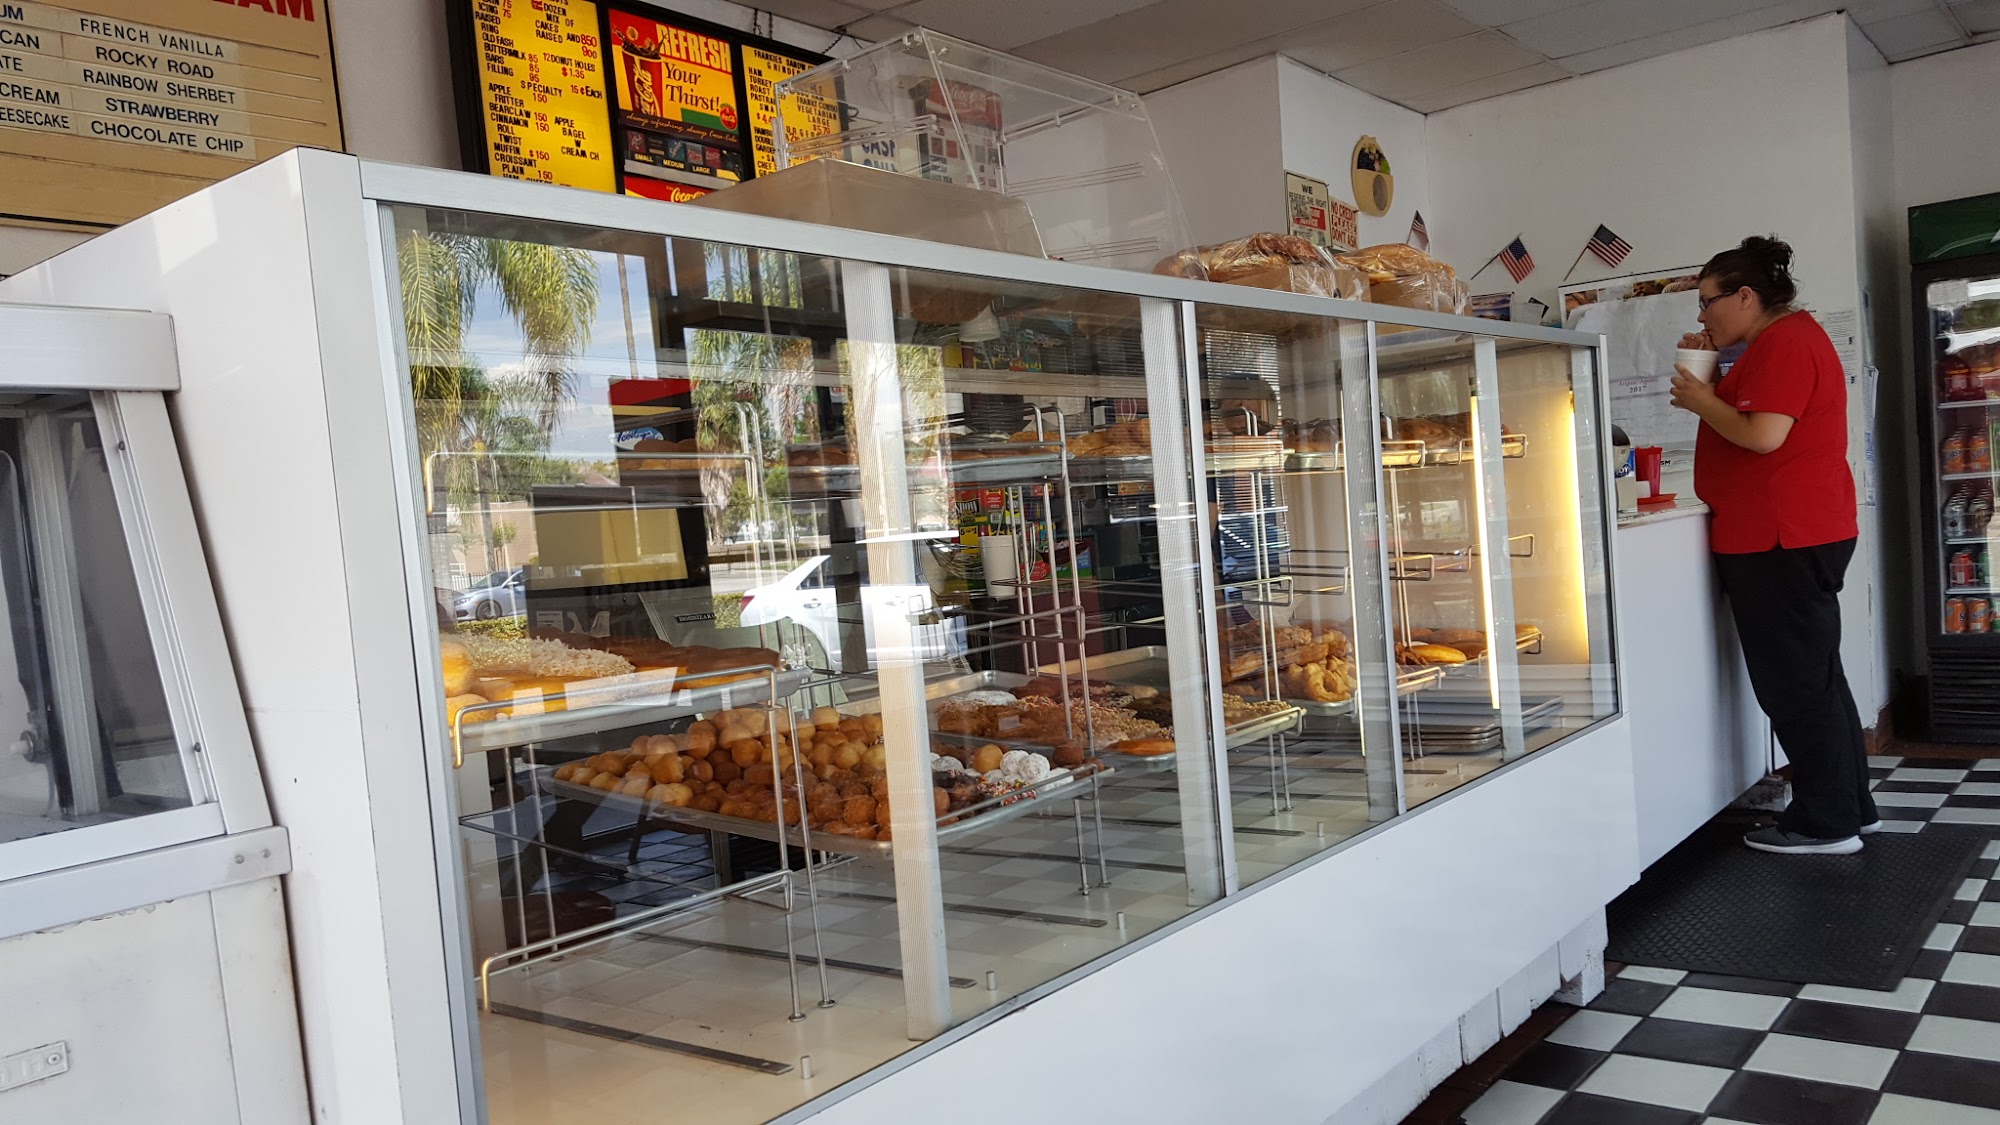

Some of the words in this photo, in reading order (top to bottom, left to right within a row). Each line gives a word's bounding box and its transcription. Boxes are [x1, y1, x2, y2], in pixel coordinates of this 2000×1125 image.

[502, 8, 512, 18] 75
[543, 3, 567, 16] DOZEN
[474, 10, 501, 25] RAISED
[545, 13, 559, 24] MIX
[564, 18, 575, 28] OF
[480, 22, 499, 34] RING
[535, 19, 559, 33] CAKES
[566, 32, 580, 43] AND
[580, 34, 597, 47] 850
[80, 17, 150, 44] FRENCH
[158, 33, 224, 58] VANILLA
[536, 30, 563, 44] RAISED
[582, 45, 598, 59] 900
[484, 42, 527, 61] BUTTERMILK
[528, 53, 538, 63] 85
[656, 23, 731, 73] REFRESH
[0, 55, 23, 71] TE
[95, 46, 158, 69] ROCKY
[167, 59, 214, 79] ROAD
[485, 52, 505, 65] BARS
[528, 63, 540, 73] 85
[486, 62, 514, 77] FILLING
[574, 59, 596, 72] HOLES
[664, 61, 701, 86] Your
[748, 67, 763, 77] HAM
[83, 69, 158, 93] RAINBOW
[167, 83, 236, 104] SHERBET
[520, 80, 563, 97] SPECIALTY
[749, 74, 772, 88] TURKEY
[488, 82, 512, 96] APPLE
[750, 83, 770, 96] ROAST
[494, 93, 525, 108] FRITTER
[532, 92, 548, 104] 150
[666, 84, 720, 113] Thirst!
[105, 98, 220, 127] STRAWBERRY
[534, 112, 548, 123] 150
[797, 104, 837, 120] VEGETARIAN
[490, 112, 529, 128] CINNAMON
[535, 122, 550, 132] 150
[554, 116, 575, 128] APPLE
[808, 114, 830, 128] LARGE
[91, 121, 197, 148] CHOCOLATE
[205, 137, 244, 153] CHIP
[497, 123, 515, 136] ROLL
[562, 127, 586, 140] BAGEL
[498, 133, 522, 146] TWIST
[493, 142, 521, 155] MUFFIN
[561, 146, 588, 159] CREAM
[589, 151, 600, 161] CH
[494, 152, 537, 168] CROISSANT
[634, 153, 654, 162] SMALL
[663, 159, 685, 169] MEDIUM
[502, 163, 525, 175] PLAIN
[538, 169, 553, 180] 150
[692, 165, 711, 174] LARGE
[1301, 184, 1313, 195] WE
[1315, 198, 1327, 209] RIGHT
[1331, 200, 1339, 215] NO
[1339, 204, 1357, 223] CREDIT
[1331, 214, 1357, 234] PLEASE
[1347, 233, 1358, 249] ASK
